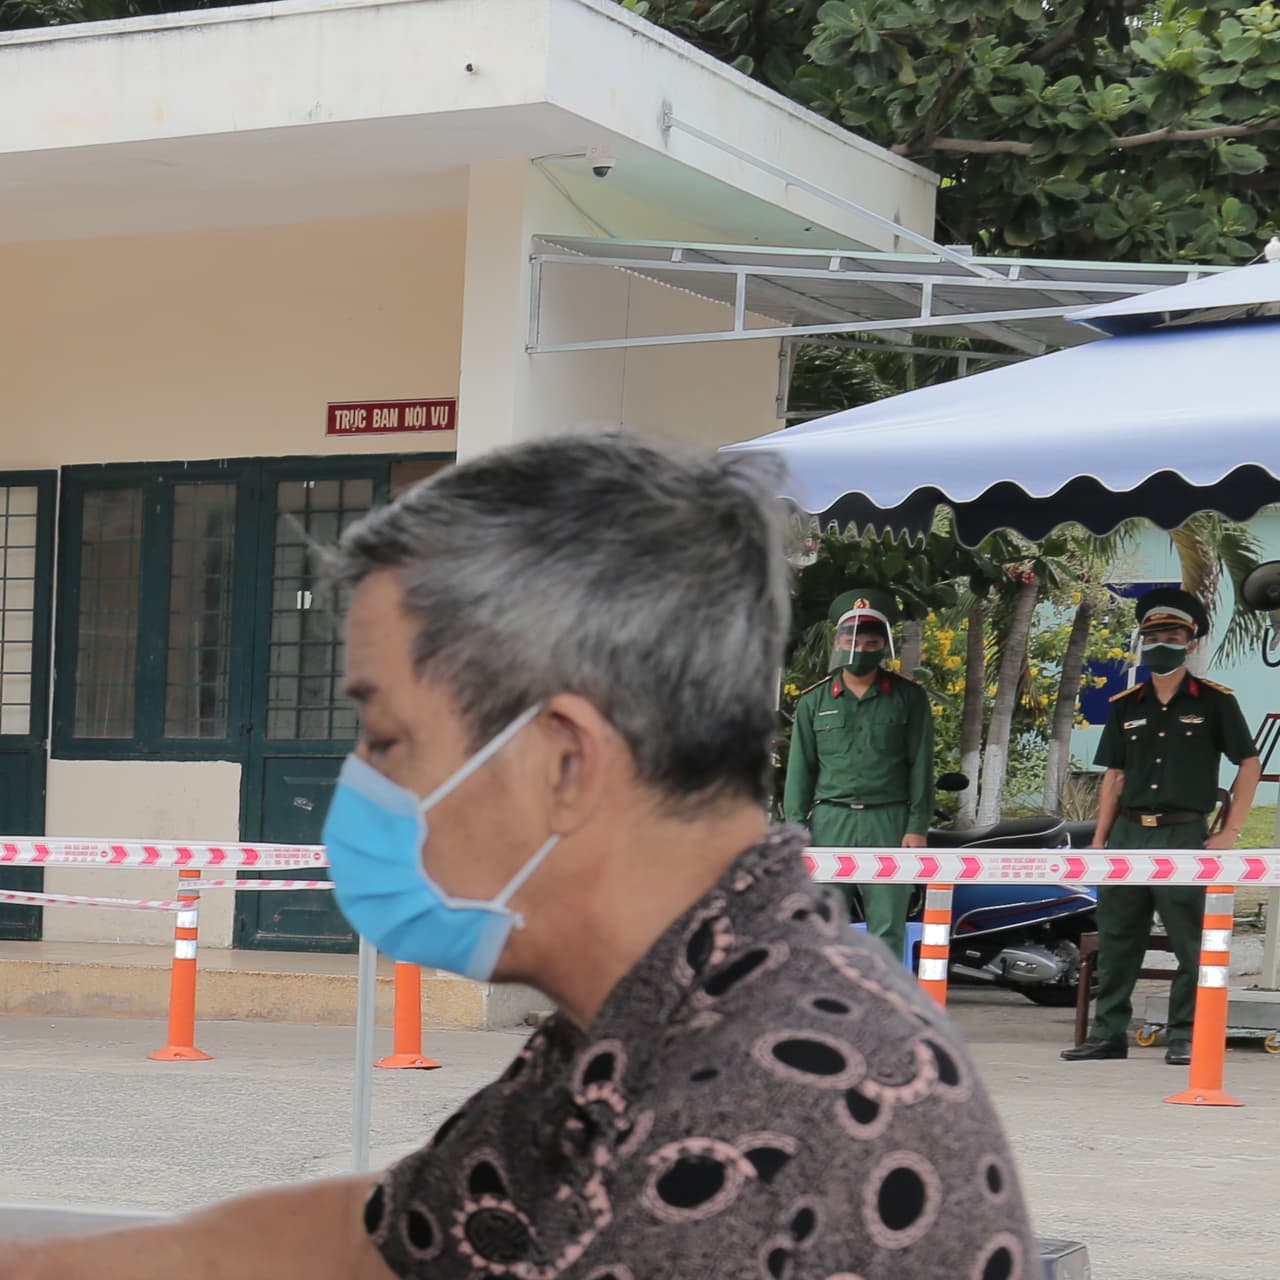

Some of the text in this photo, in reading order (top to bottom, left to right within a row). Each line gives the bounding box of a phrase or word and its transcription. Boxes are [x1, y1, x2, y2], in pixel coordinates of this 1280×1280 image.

[335, 408, 366, 431] TRỰC
[372, 408, 398, 428] BAN
[431, 405, 449, 427] VỤ
